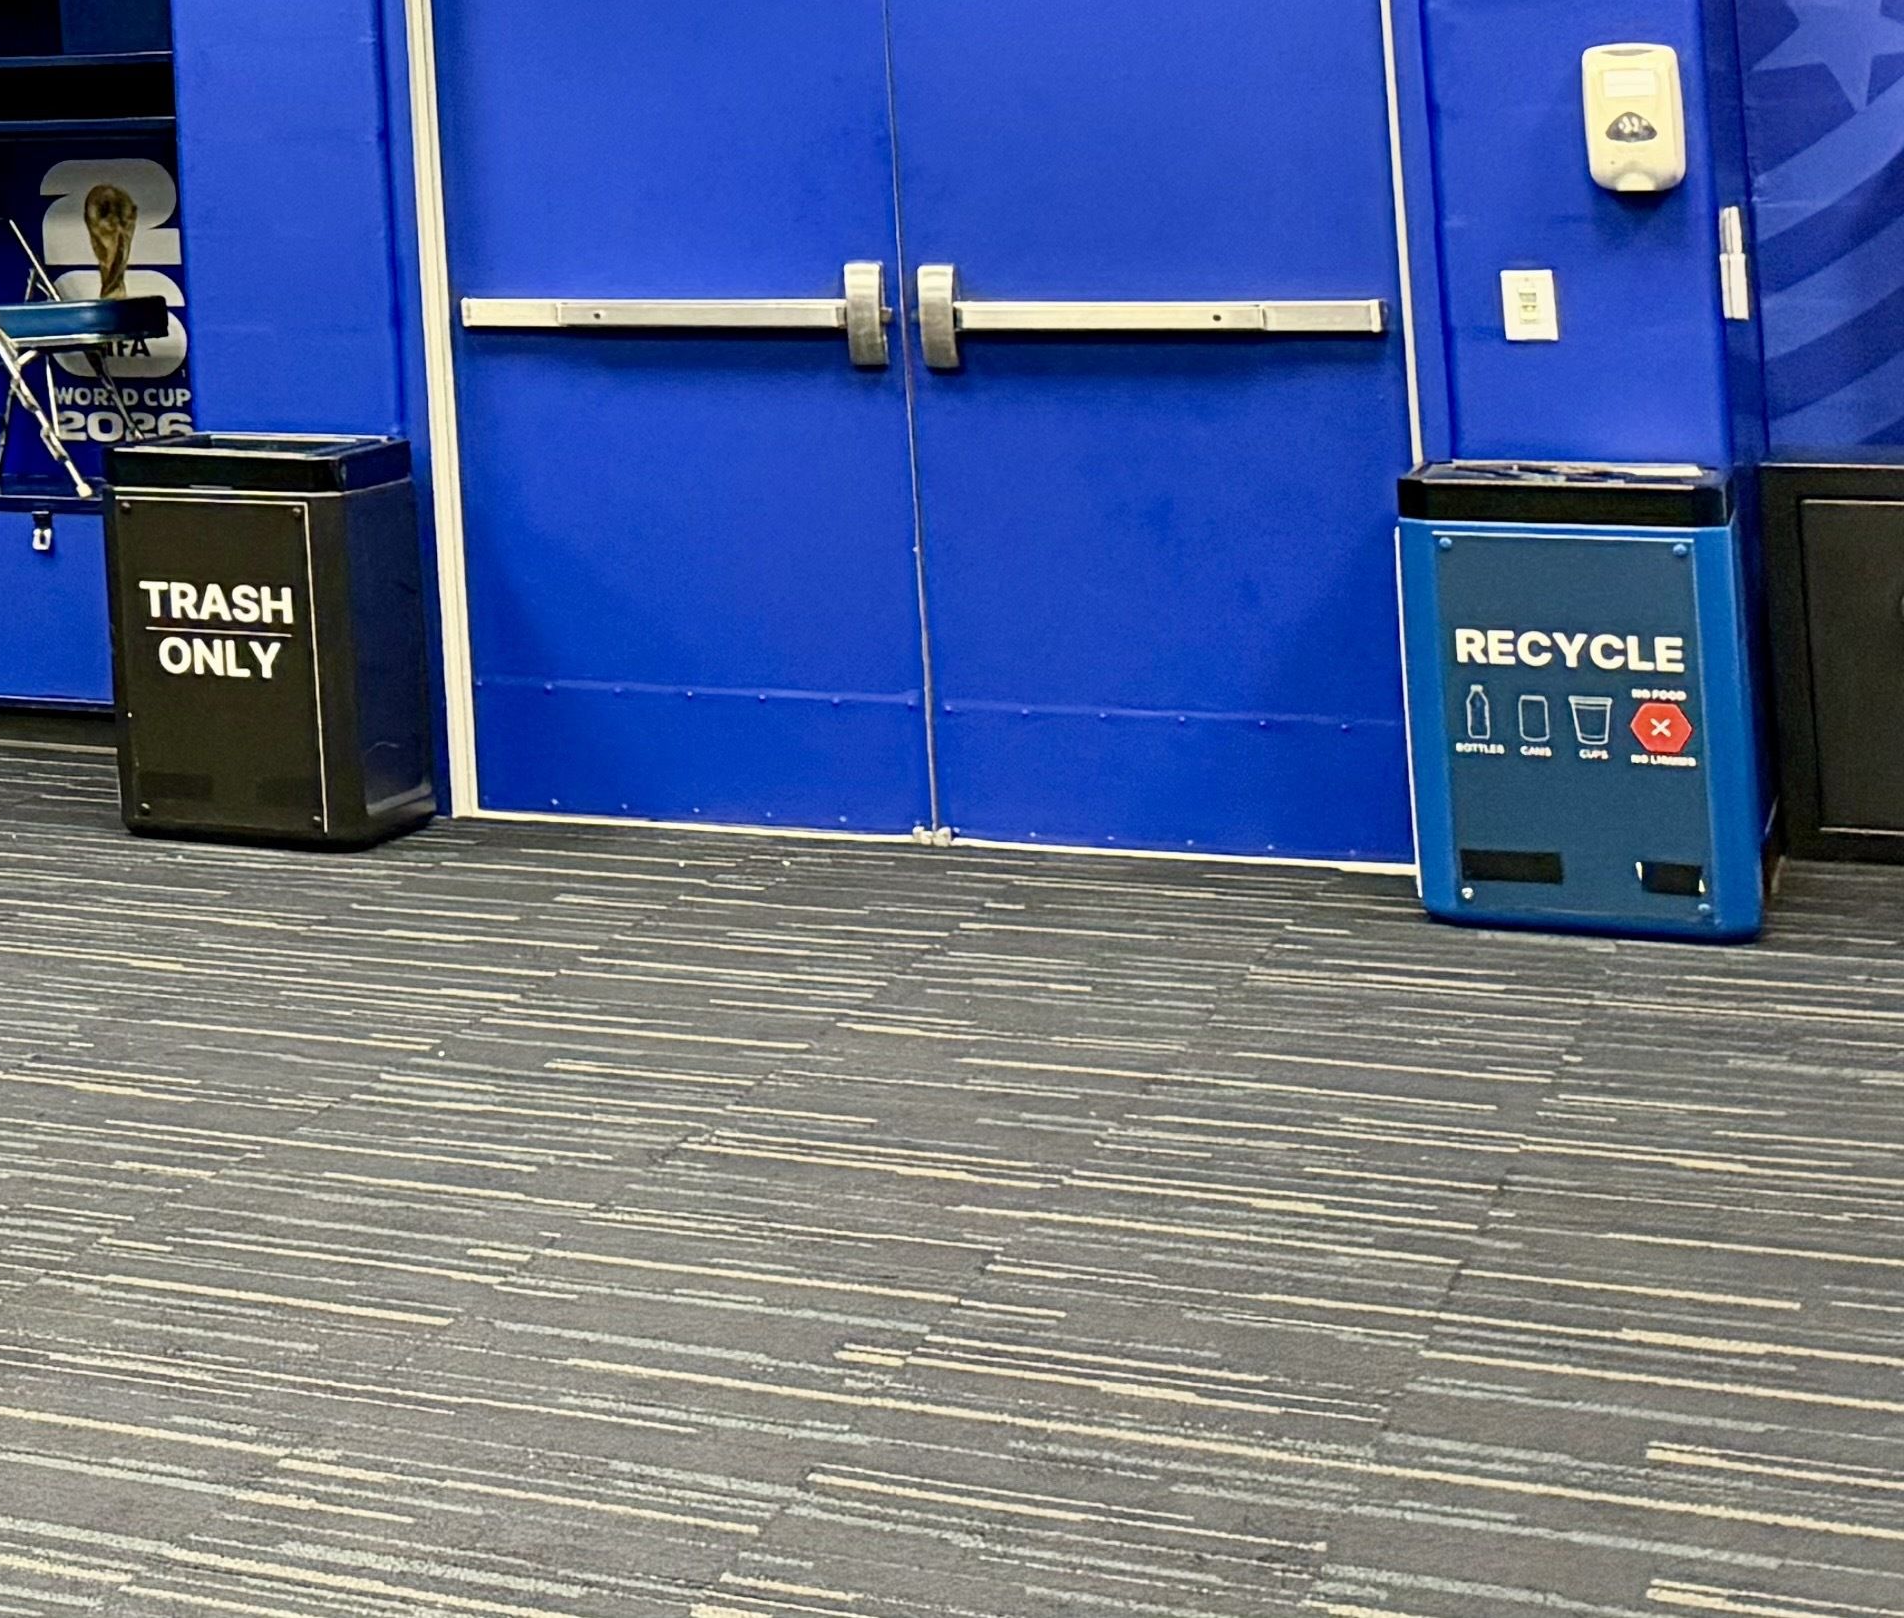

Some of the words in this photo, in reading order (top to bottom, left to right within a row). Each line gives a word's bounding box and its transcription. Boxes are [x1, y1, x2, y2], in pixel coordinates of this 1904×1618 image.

[55, 386, 140, 407] WORD
[143, 387, 192, 408] CUP
[139, 580, 294, 624] TRASH
[158, 636, 282, 679] ONLY
[1455, 628, 1686, 673] RECYCLE
[1455, 742, 1505, 755] BOTTLES
[1520, 745, 1553, 757] CANS
[1579, 748, 1609, 760] CUPS
